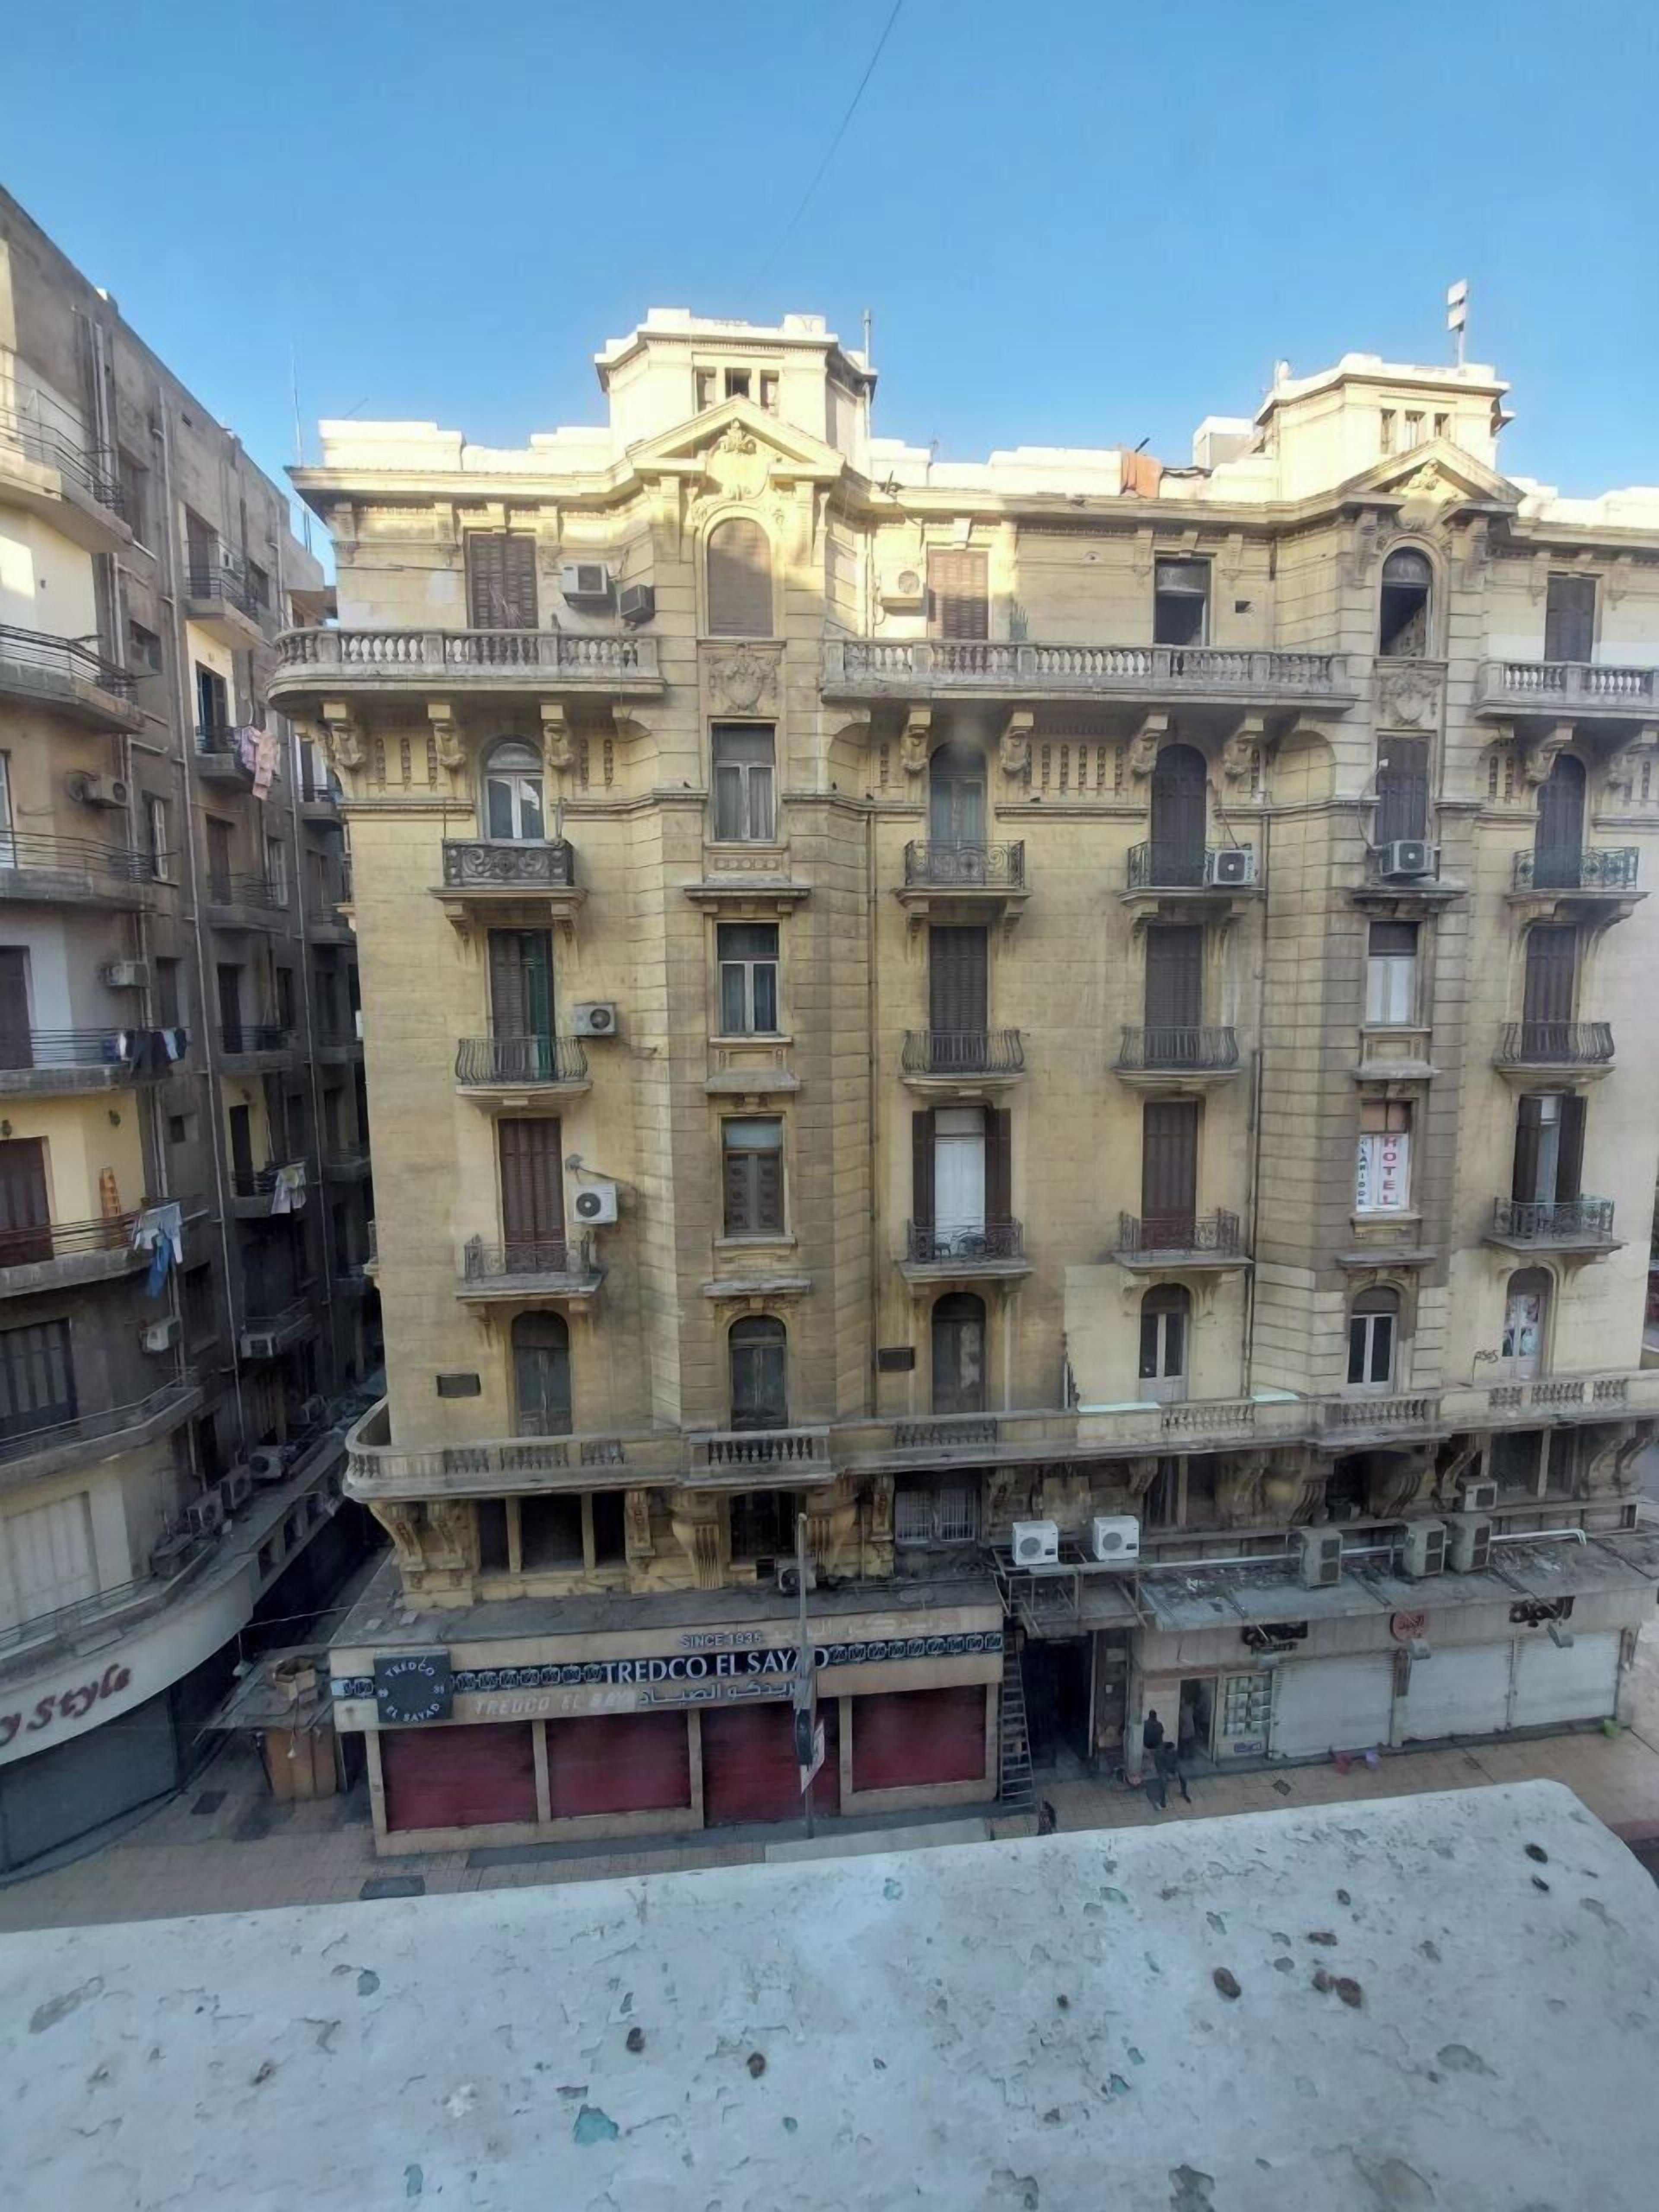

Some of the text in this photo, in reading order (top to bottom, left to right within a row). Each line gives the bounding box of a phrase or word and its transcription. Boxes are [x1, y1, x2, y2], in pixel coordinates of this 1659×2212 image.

[1383, 1136, 1397, 1205] HOTEL
[680, 1634, 722, 1647] SINCE
[601, 1656, 707, 1684] TREDCO
[716, 1654, 741, 1677] EL
[727, 1681, 795, 1700] ريدكو
